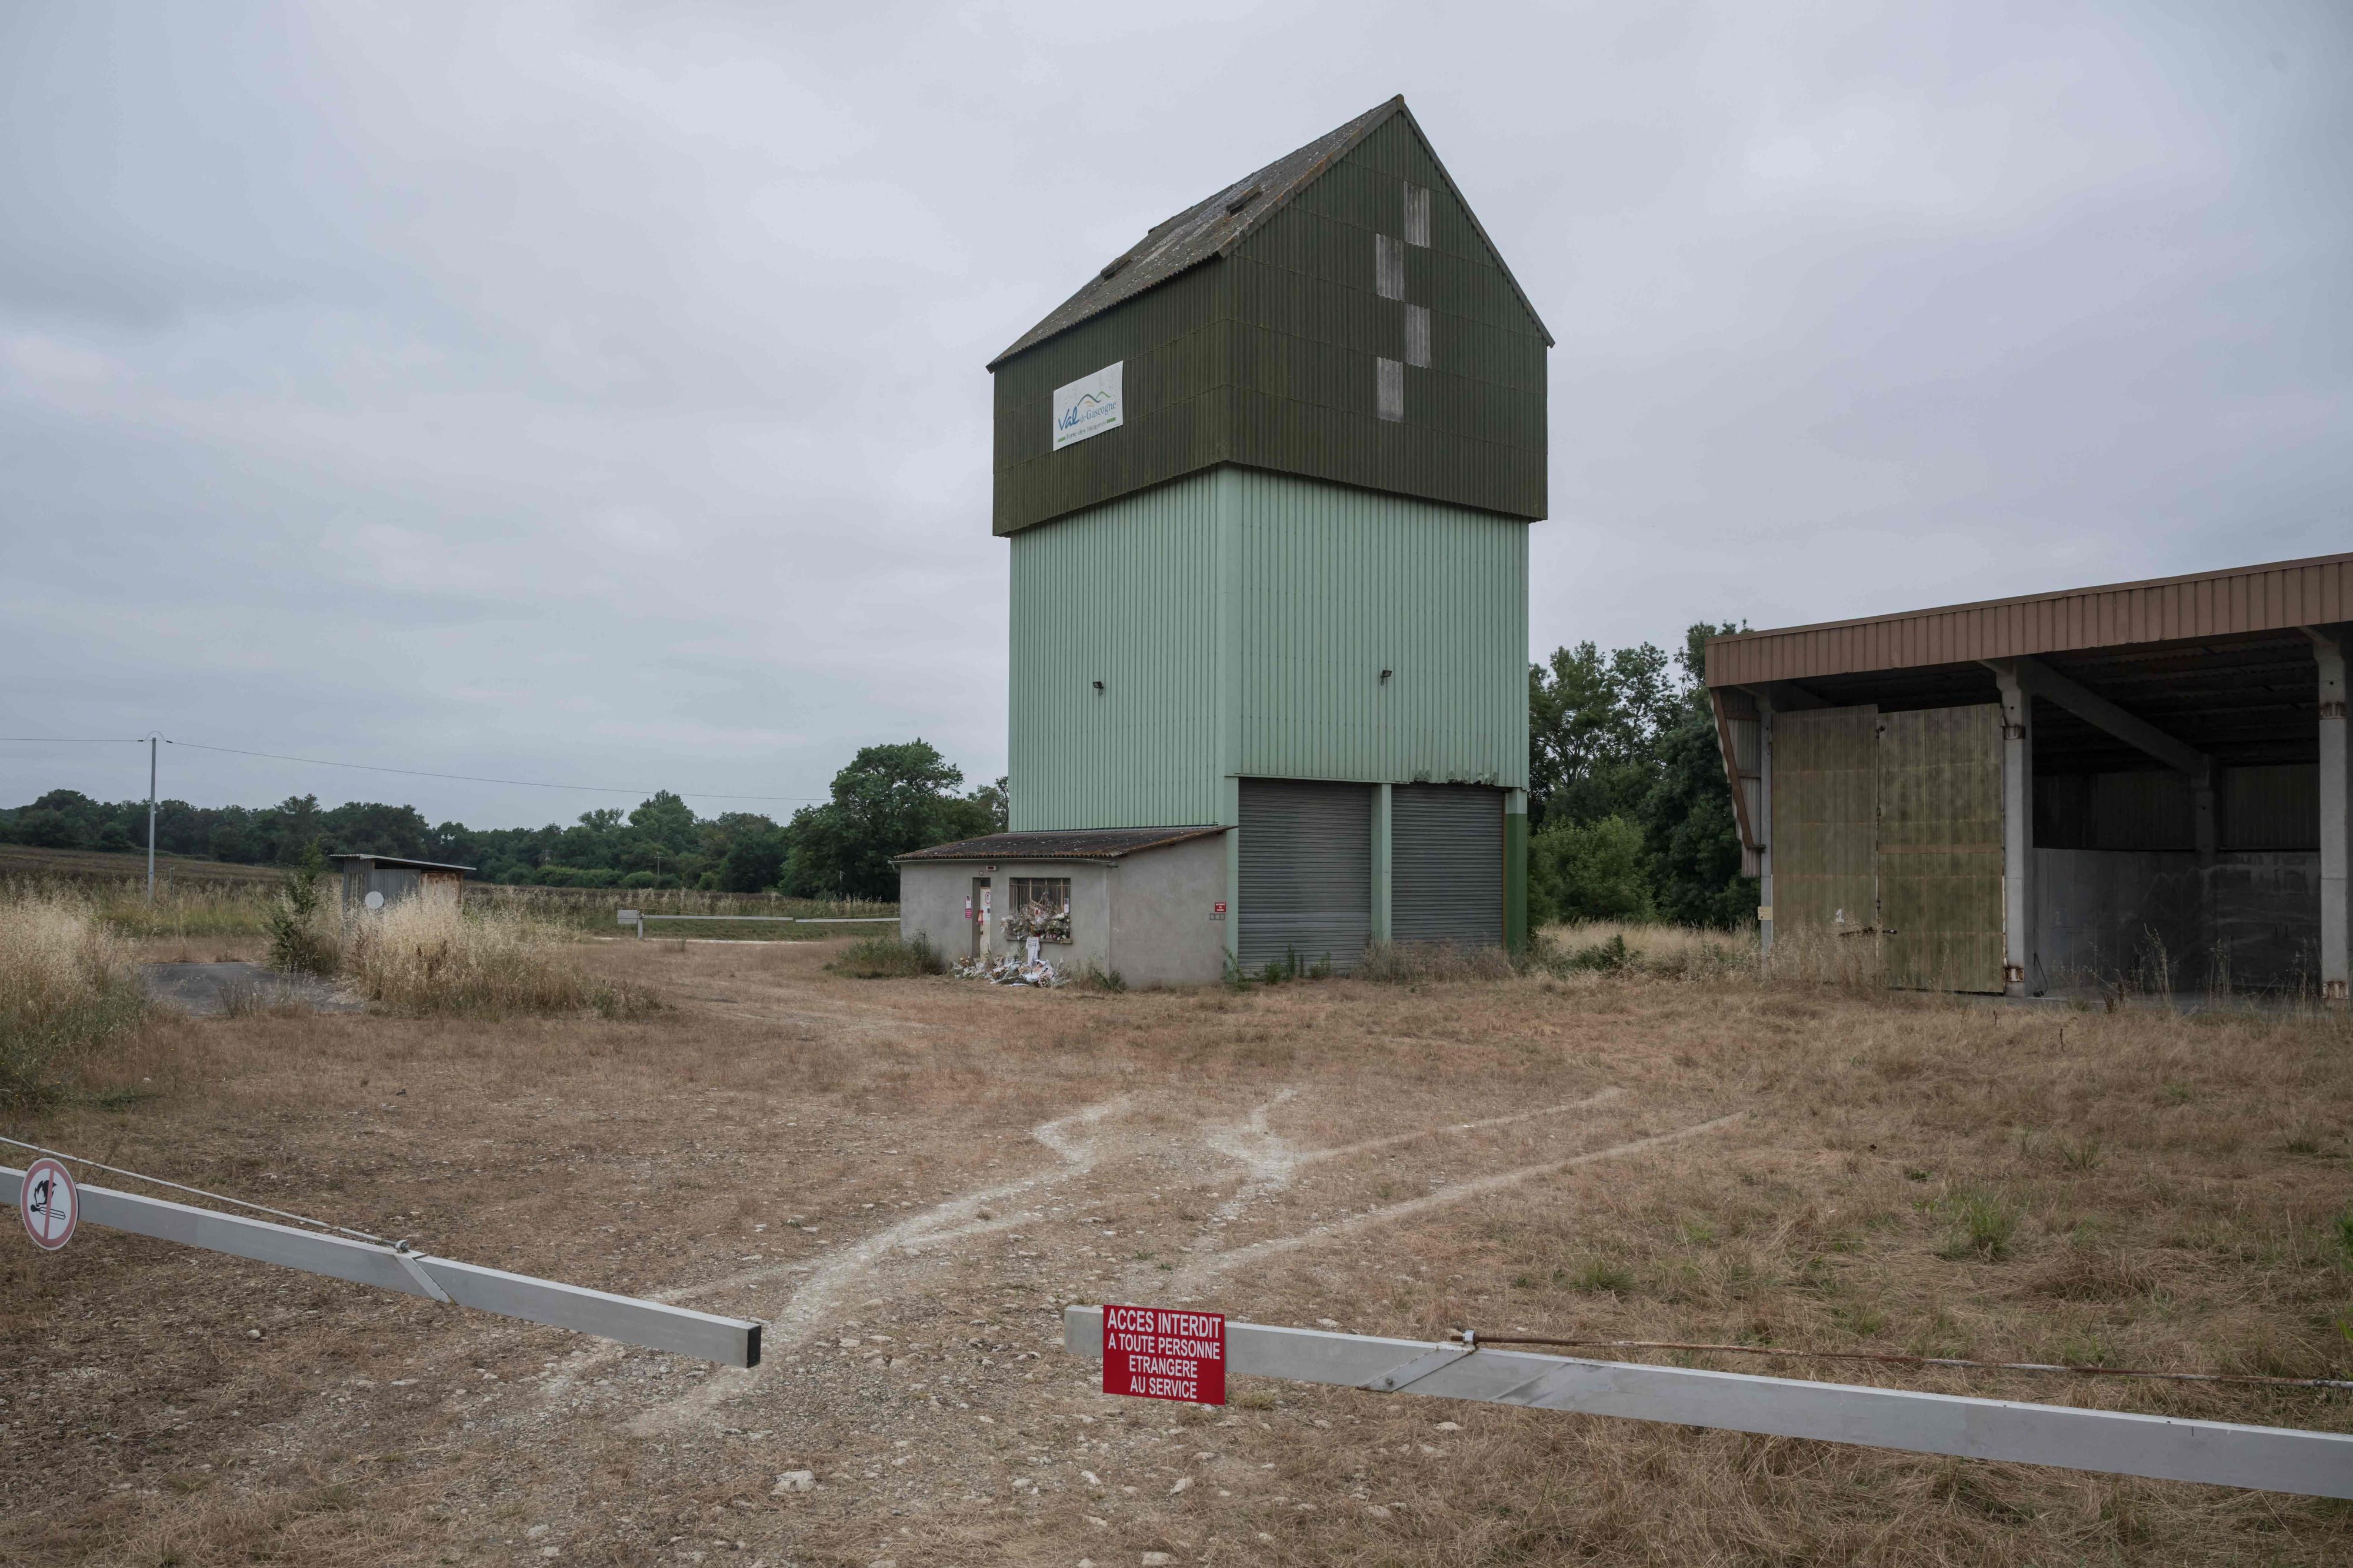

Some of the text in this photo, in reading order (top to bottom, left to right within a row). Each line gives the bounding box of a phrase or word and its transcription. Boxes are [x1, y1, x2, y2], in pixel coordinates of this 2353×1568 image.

[1058, 401, 1116, 431] Val de Gascogne
[1835, 909, 1844, 922] 1
[1107, 1308, 1221, 1338] ACCES INTERDIT
[1108, 1333, 1220, 1360] A TOUTE PERSONNE
[1129, 1355, 1198, 1378] ETRANGERE
[1130, 1376, 1197, 1399] AU SERVICE
